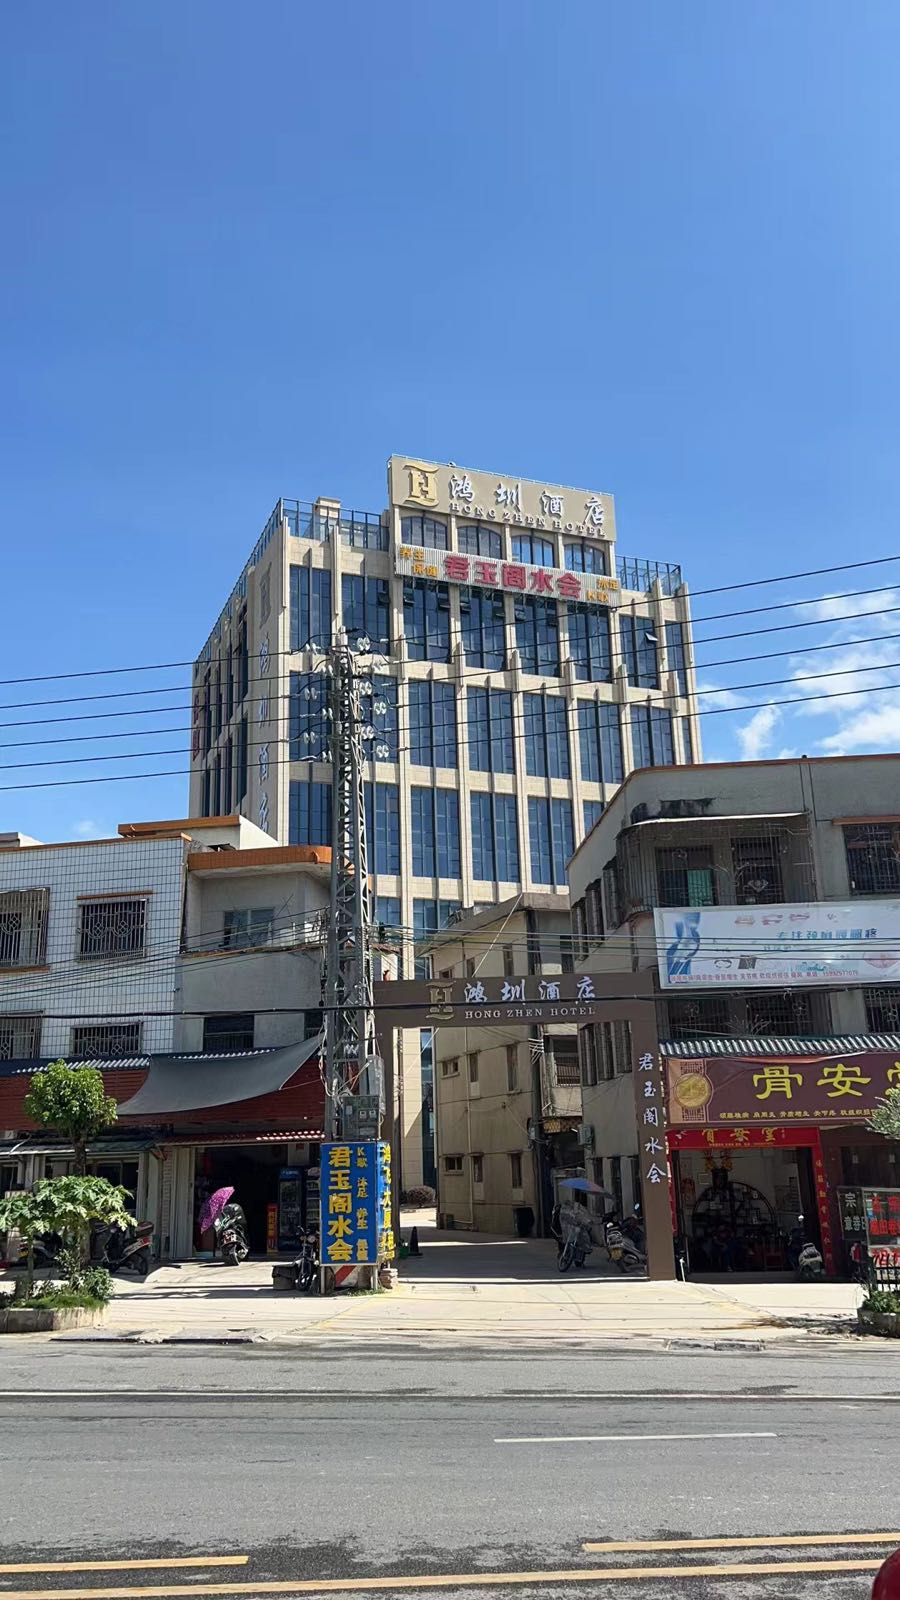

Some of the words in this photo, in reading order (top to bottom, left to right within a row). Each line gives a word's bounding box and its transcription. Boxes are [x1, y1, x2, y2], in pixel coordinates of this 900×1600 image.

[449, 474, 604, 525] 鸿圳酒店
[450, 502, 496, 519] HONG
[503, 511, 546, 527] ZHEN
[554, 519, 605, 537] HOTEL
[444, 555, 582, 599] 君玉阁水会
[464, 976, 597, 1005] 鸿圳酒店
[465, 1010, 501, 1019] HONG
[507, 1008, 543, 1018] ZHEN
[550, 1007, 596, 1017] HOTEL
[638, 1053, 667, 1183] 君玉阁水会
[355, 1147, 368, 1168] K歌
[327, 1146, 354, 1261] 君玉阁水会
[356, 1207, 368, 1230] 养生
